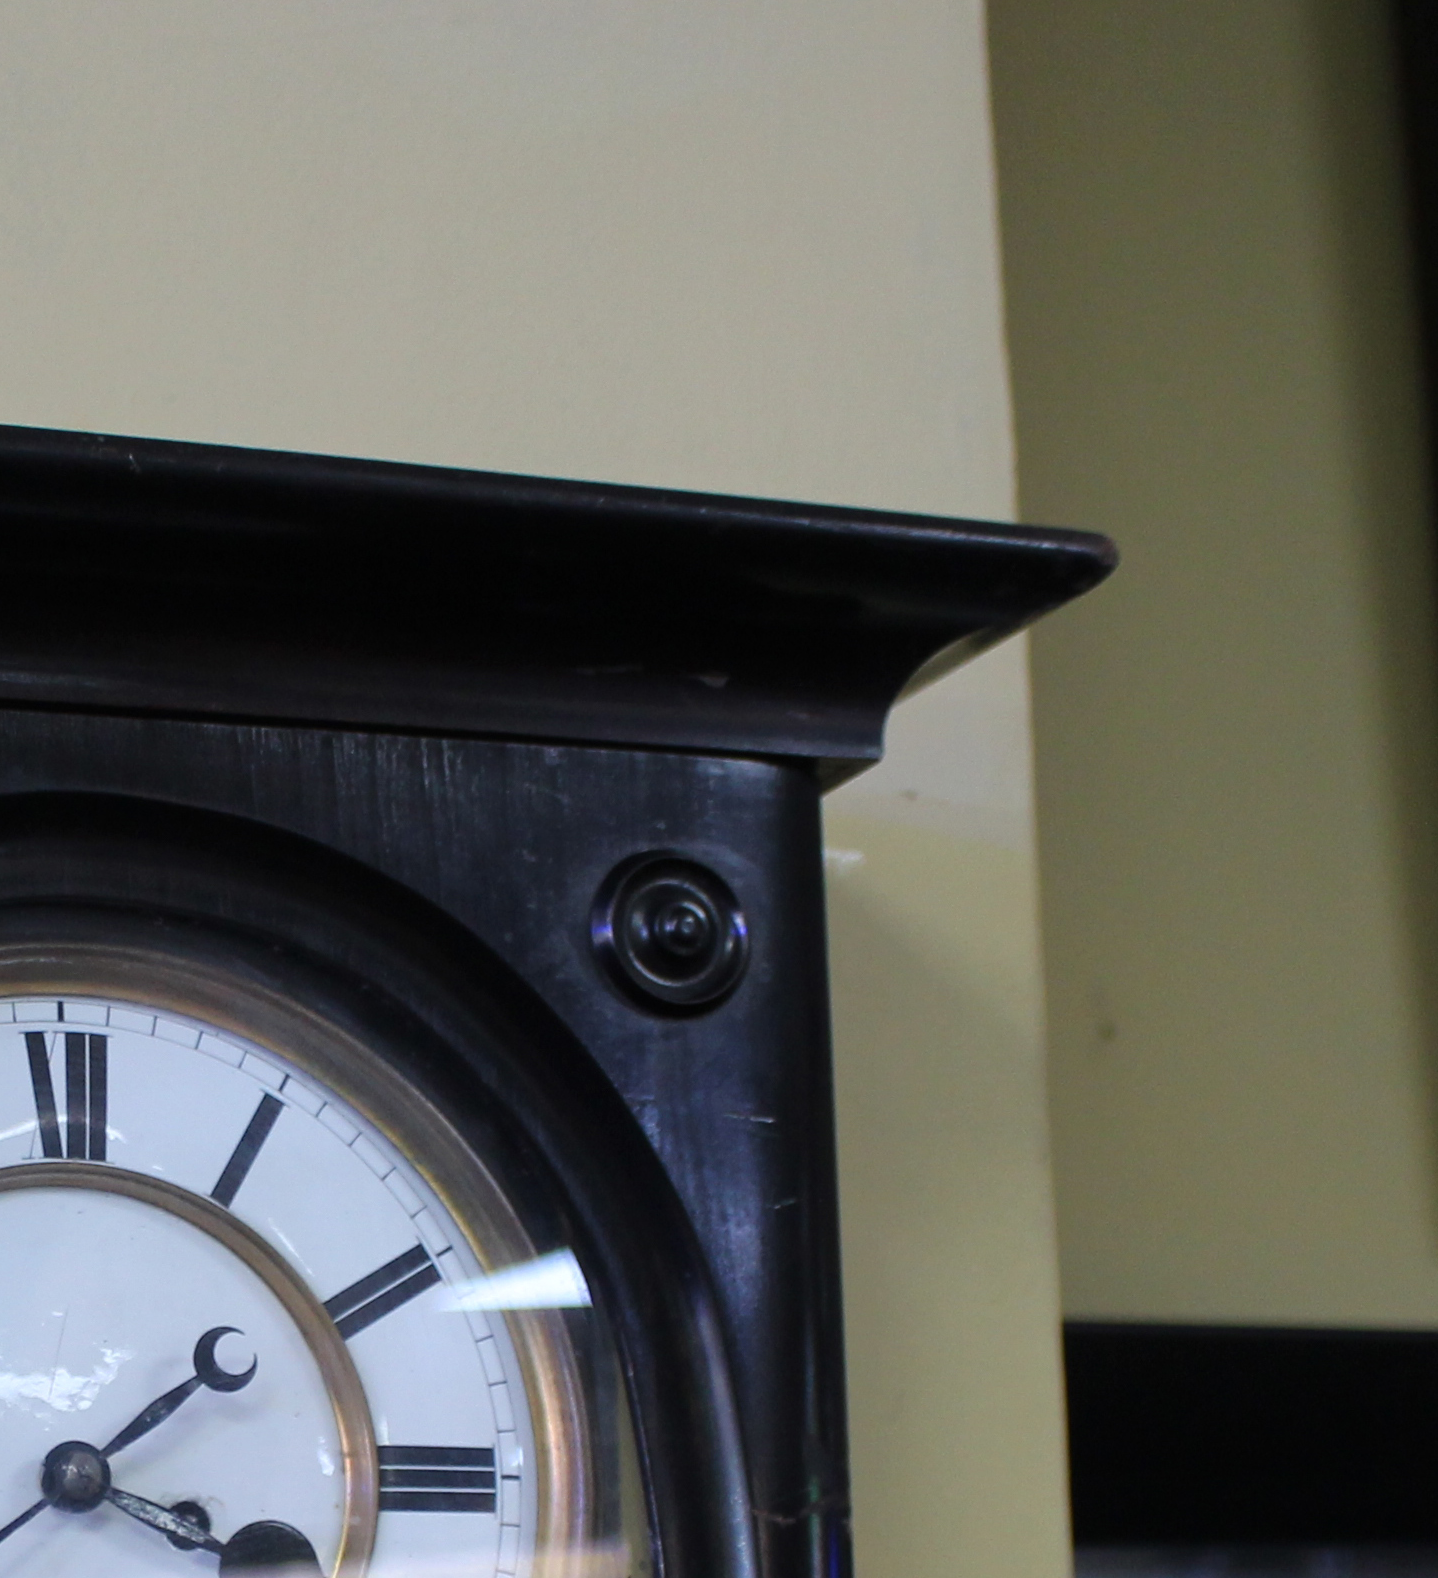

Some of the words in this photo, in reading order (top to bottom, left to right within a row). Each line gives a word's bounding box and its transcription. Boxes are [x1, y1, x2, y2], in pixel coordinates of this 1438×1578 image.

[19, 1031, 113, 1163] XII
[204, 1088, 289, 1209] I
[322, 1238, 446, 1342] II
[377, 1445, 497, 1517] III
